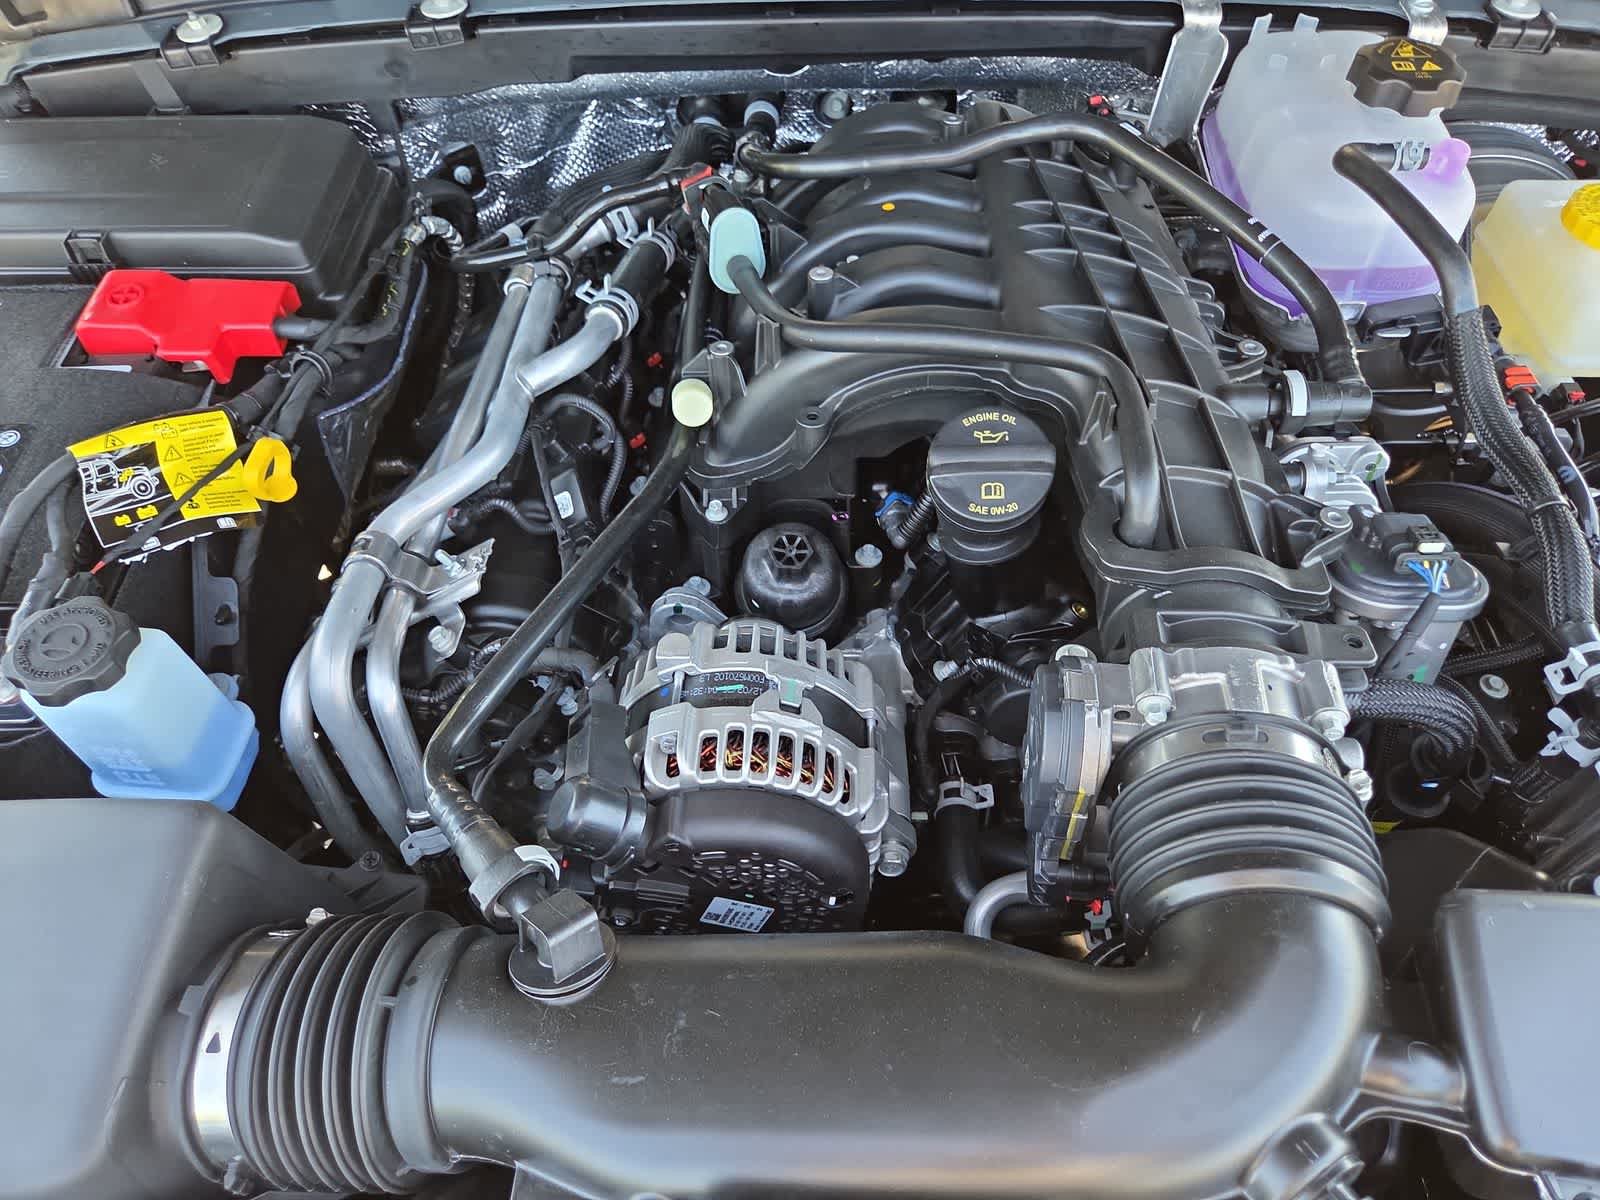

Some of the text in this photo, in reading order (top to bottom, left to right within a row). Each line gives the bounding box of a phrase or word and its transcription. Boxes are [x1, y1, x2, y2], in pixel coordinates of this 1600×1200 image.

[961, 412, 1017, 427] ENGINE OIL
[967, 502, 1018, 515] SAE 0W-20
